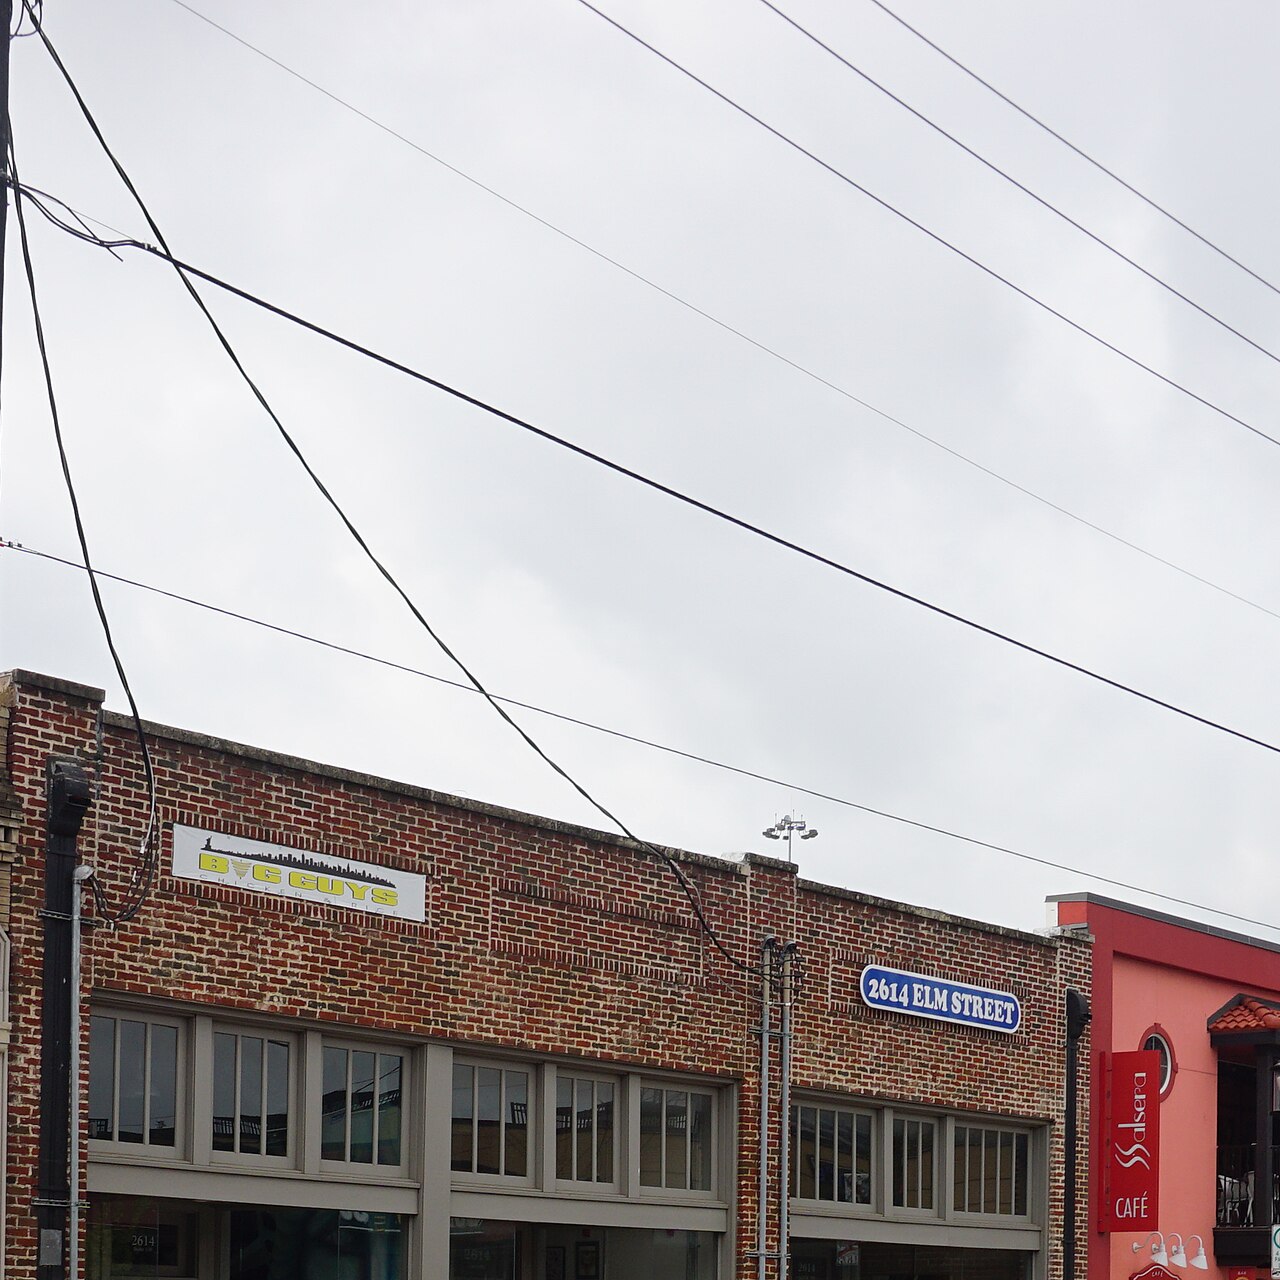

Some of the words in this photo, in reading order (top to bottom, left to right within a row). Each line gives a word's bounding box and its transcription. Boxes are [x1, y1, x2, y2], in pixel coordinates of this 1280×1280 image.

[288, 871, 398, 906] GUYS
[868, 978, 909, 1007] 2614
[912, 983, 948, 1012] ELM
[950, 992, 1015, 1024] STREET
[1115, 1191, 1148, 1218] CAFÉ
[132, 1234, 156, 1247] 2614
